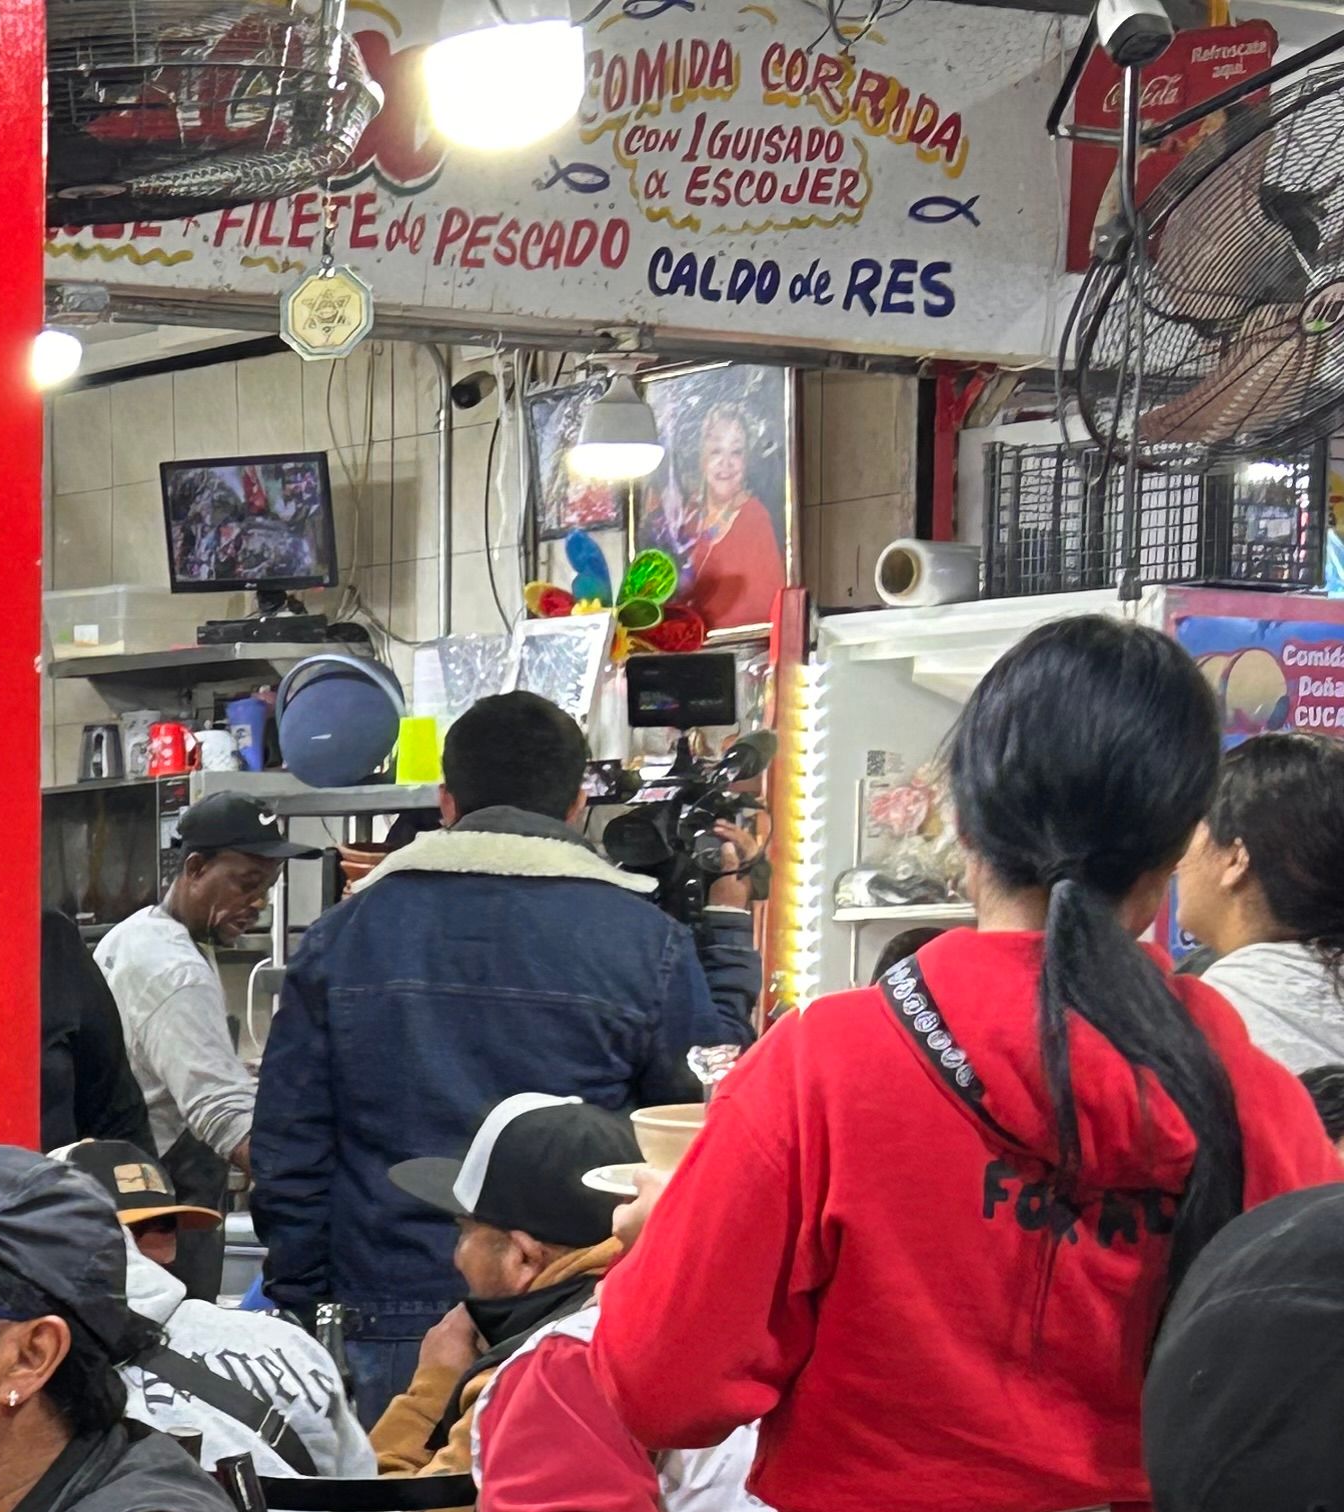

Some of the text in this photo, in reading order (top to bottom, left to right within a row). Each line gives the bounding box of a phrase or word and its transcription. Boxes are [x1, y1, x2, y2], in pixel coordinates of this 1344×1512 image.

[580, 37, 963, 163] COMIDA CORRIDA
[707, 120, 845, 164] GUISADO
[684, 165, 861, 209] ESCOJER
[385, 203, 426, 254] de
[432, 208, 631, 271] PESCADO
[647, 246, 958, 318] CALDO de RES
